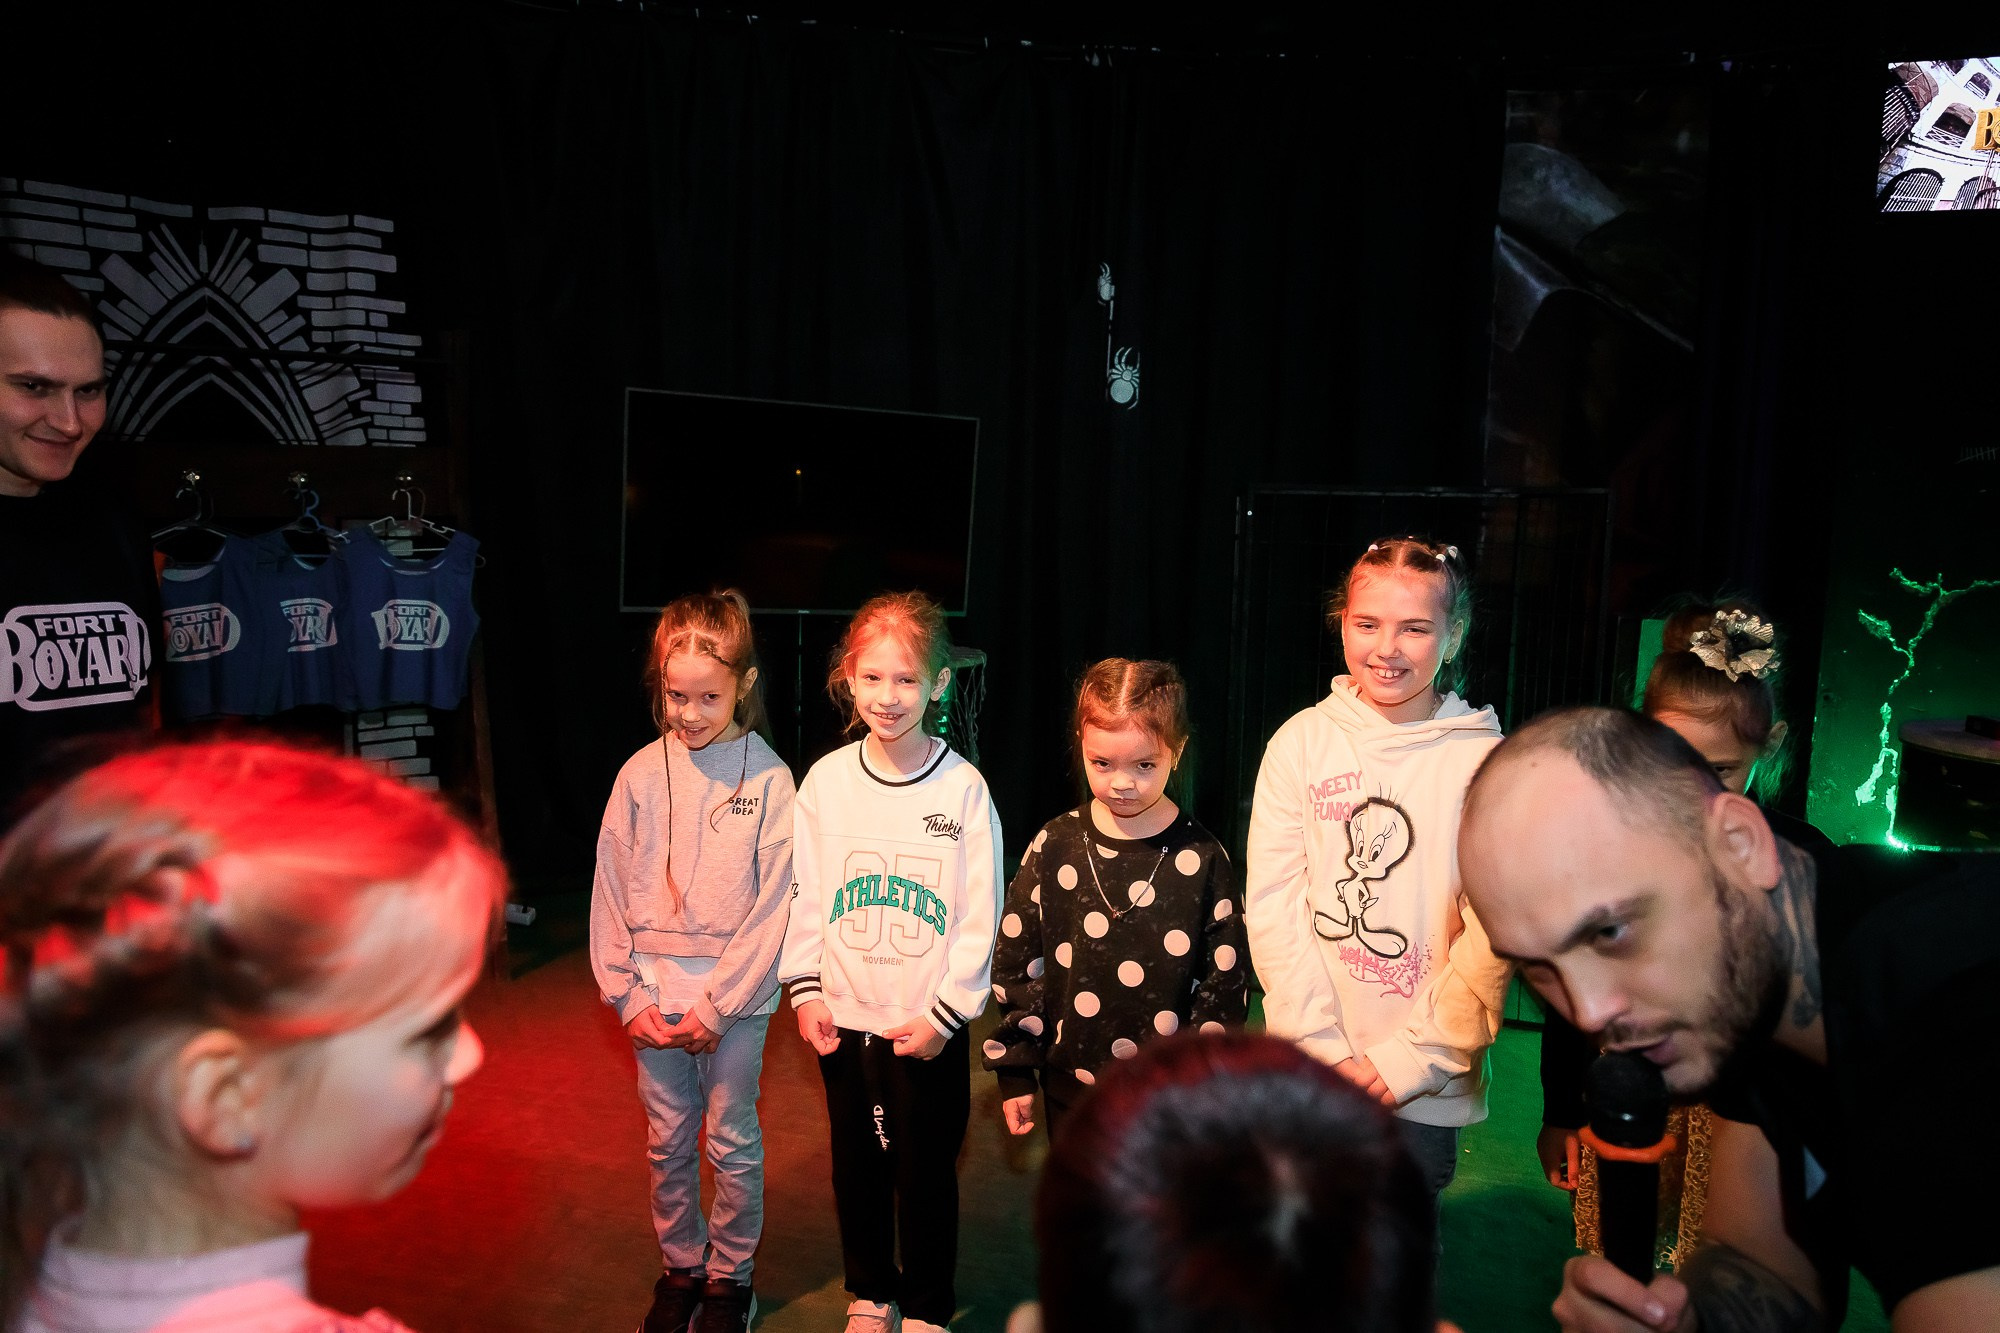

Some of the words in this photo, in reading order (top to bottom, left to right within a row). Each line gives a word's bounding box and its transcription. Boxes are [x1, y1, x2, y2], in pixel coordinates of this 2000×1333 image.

[34, 614, 116, 637] FORT
[0, 614, 152, 703] BOYARD
[829, 874, 947, 936] ATHLETICS
